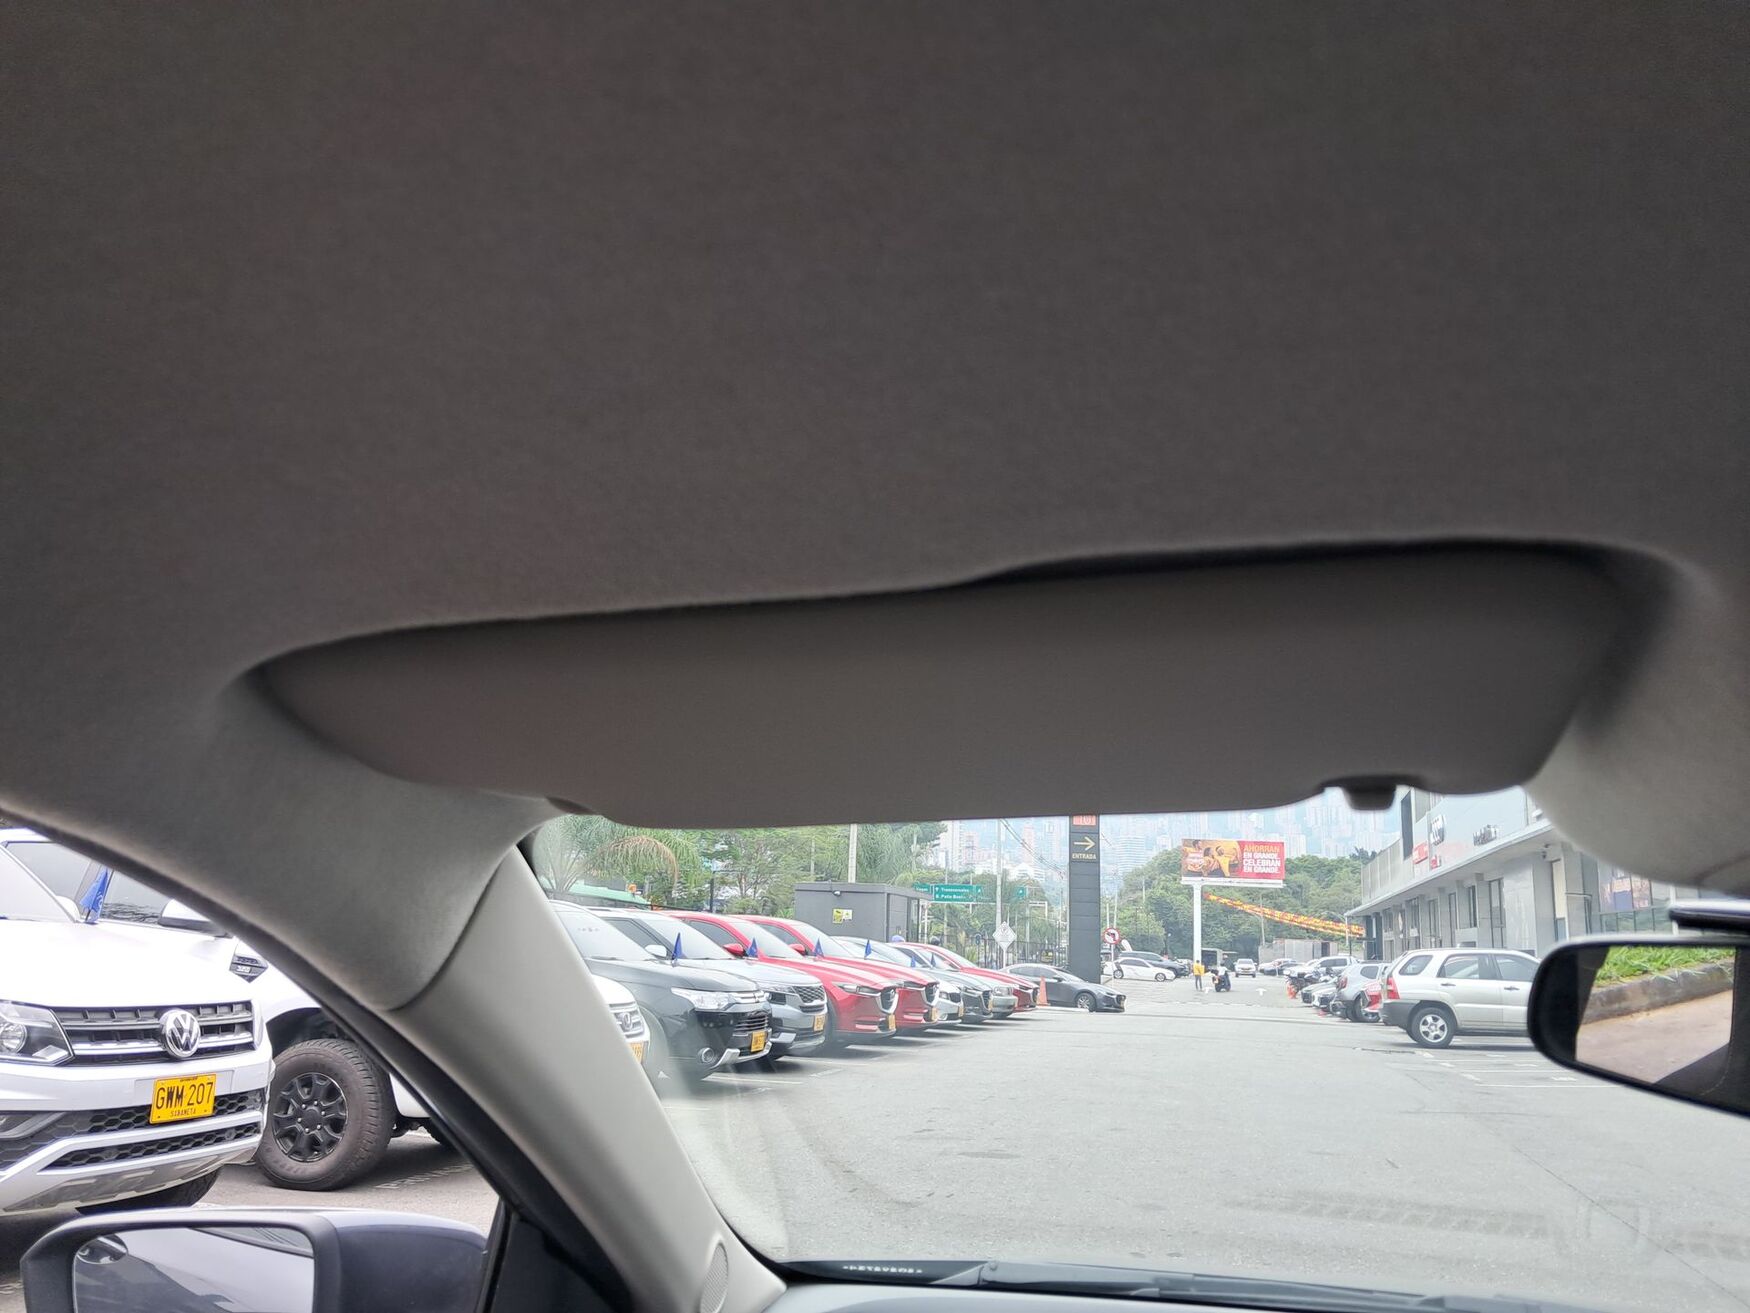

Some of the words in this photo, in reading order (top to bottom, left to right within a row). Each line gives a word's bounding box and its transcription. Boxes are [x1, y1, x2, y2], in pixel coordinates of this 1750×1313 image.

[1243, 844, 1280, 853] AHORRAN
[1072, 852, 1097, 860] ENTRADA
[1243, 859, 1281, 867] CELEBRAN
[156, 1085, 185, 1109] GWM
[187, 1082, 213, 1106] 207
